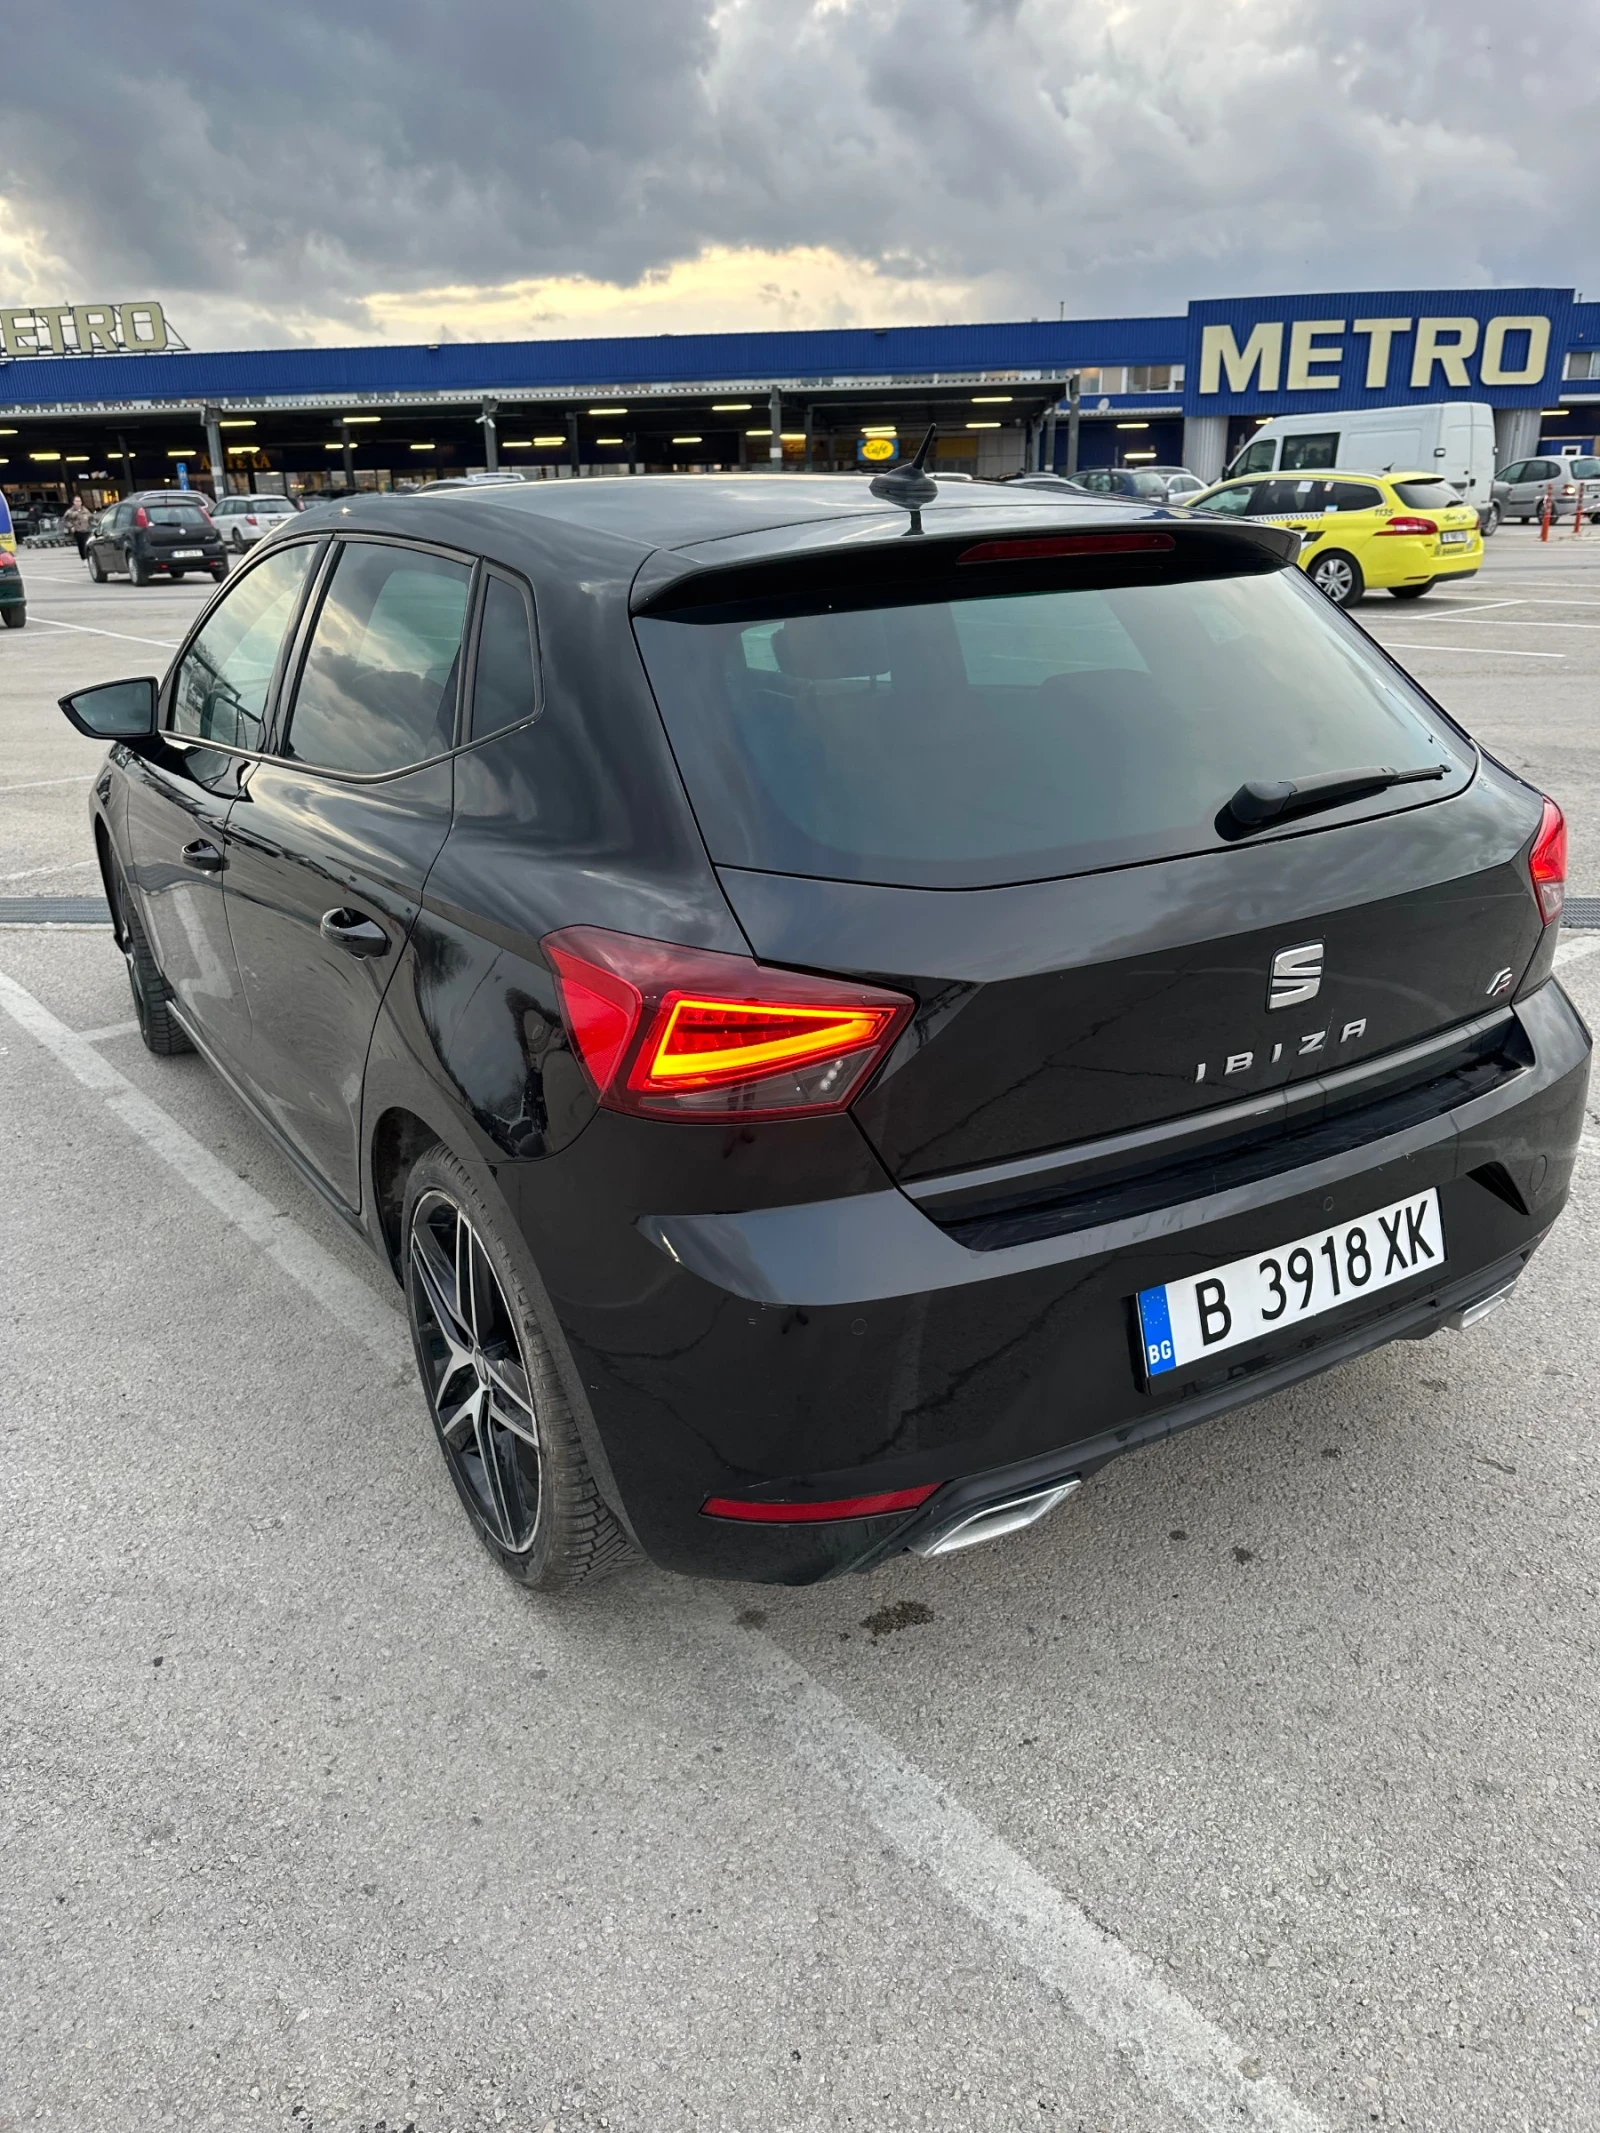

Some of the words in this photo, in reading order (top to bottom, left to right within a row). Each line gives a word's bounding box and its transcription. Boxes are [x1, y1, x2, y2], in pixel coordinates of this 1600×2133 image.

[1199, 316, 1551, 394] METRO
[1195, 1018, 1367, 1083] IBIZA
[1195, 1277, 1232, 1346] B
[1259, 1226, 1372, 1321] 3918
[1378, 1200, 1436, 1276] XK
[1148, 1339, 1172, 1365] BG
